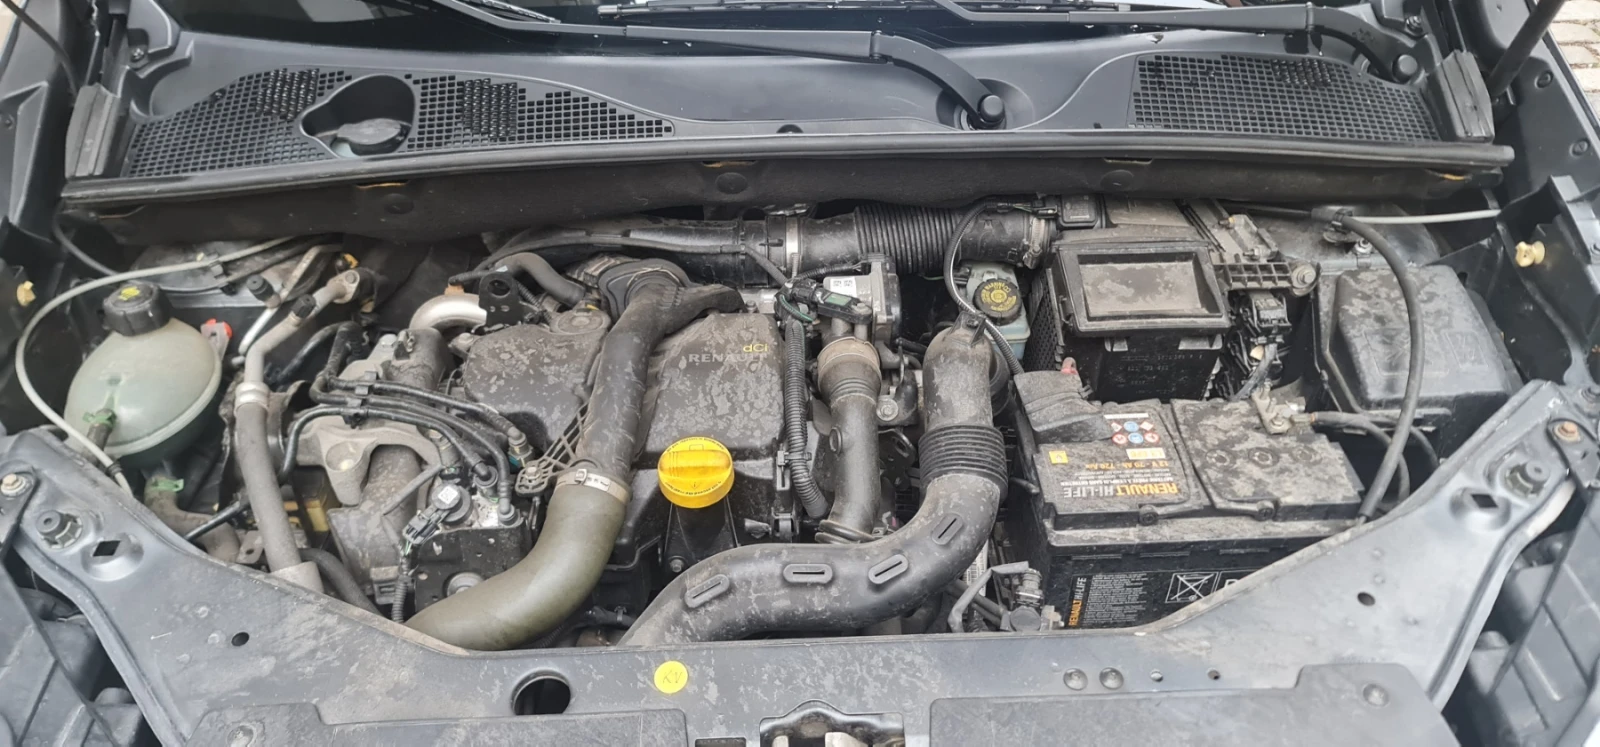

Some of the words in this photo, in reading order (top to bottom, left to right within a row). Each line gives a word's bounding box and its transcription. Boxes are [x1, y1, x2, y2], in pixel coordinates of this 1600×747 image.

[743, 343, 768, 353] dCi
[689, 353, 767, 363] RENAULT
[1117, 484, 1178, 496] RENAULT
[1068, 600, 1082, 626] RENAULT
